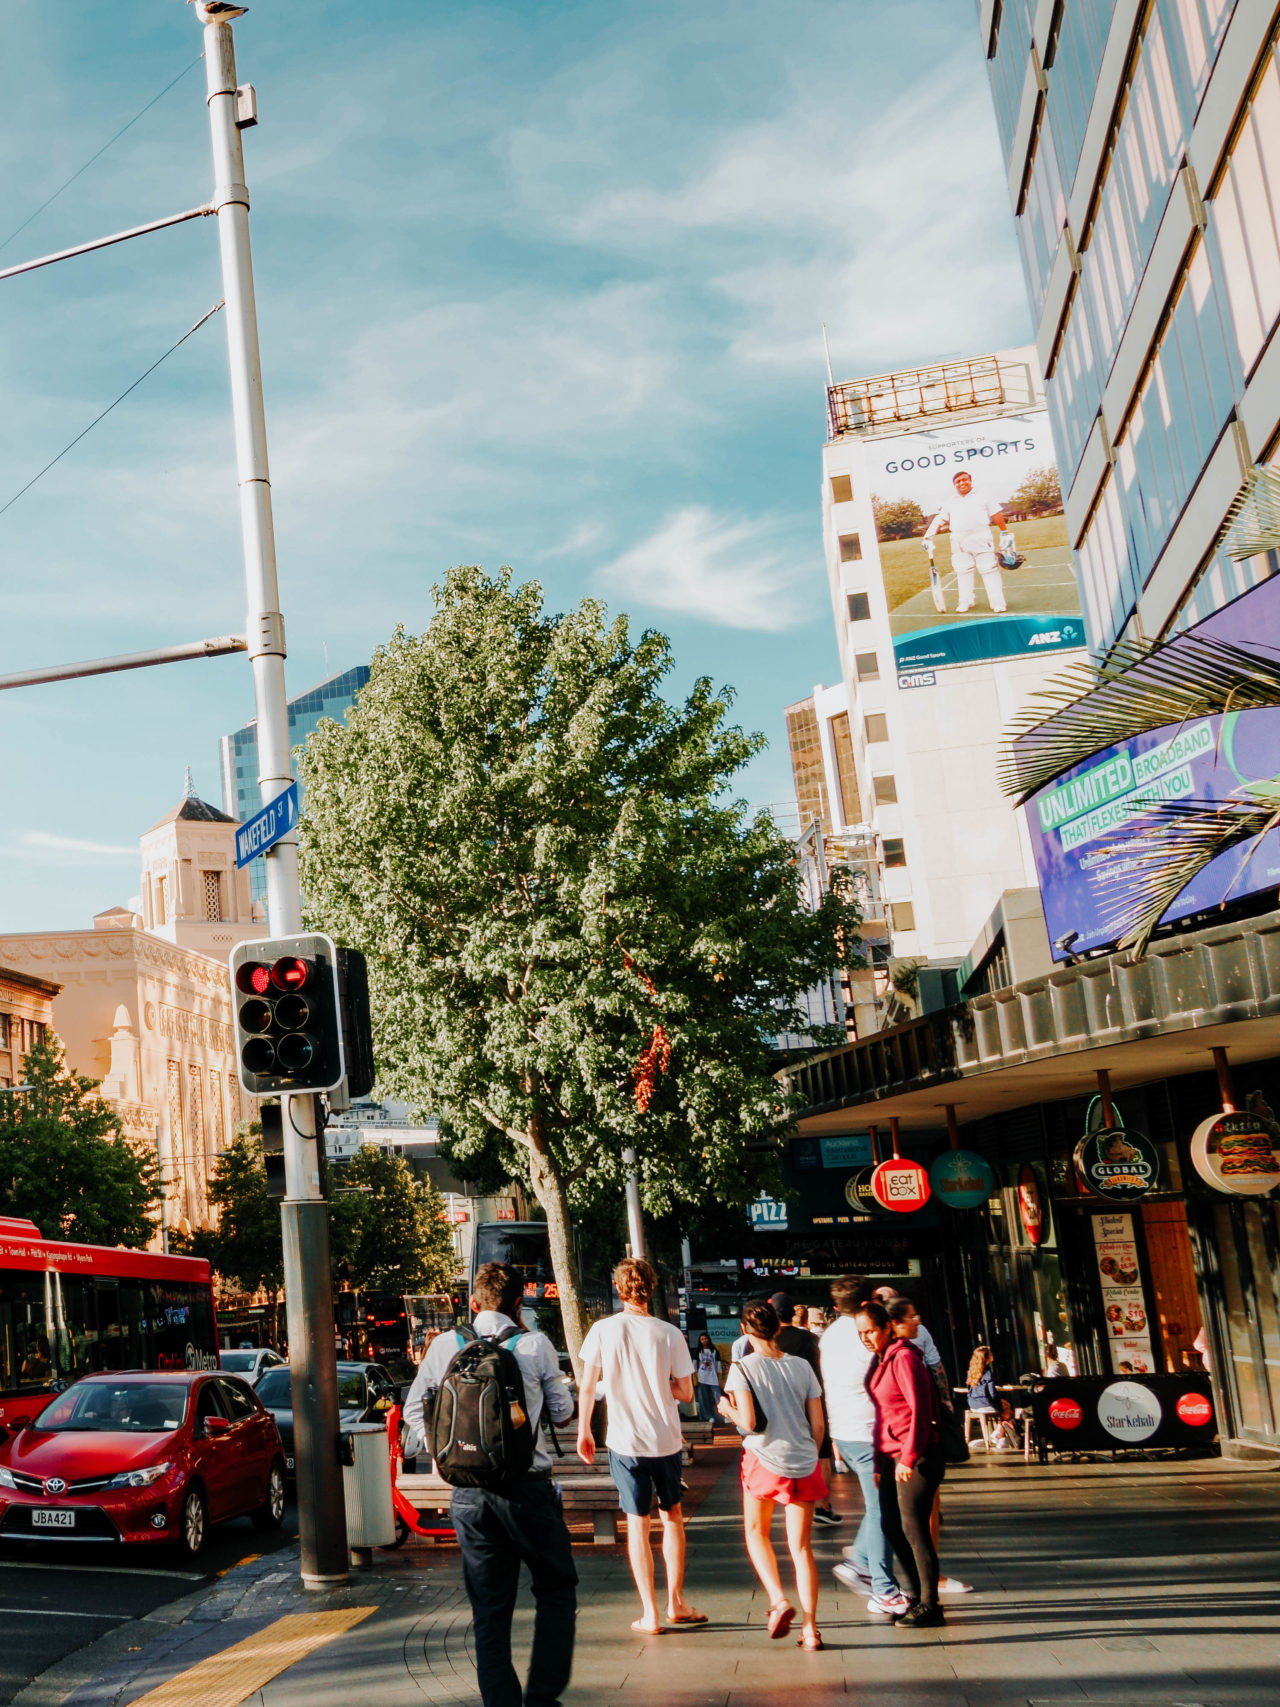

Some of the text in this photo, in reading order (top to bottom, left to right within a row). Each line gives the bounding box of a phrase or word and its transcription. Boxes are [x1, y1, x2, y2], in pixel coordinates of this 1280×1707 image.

[885, 438, 1036, 474] GOOD SPORTS
[1028, 631, 1062, 646] ANZ
[898, 672, 935, 689] QMS
[1039, 727, 1211, 827] UNLIMITED BROADBAND
[1062, 821, 1088, 847] THAT
[1090, 801, 1129, 832] FLEXES
[1130, 784, 1161, 813] WITH
[1163, 770, 1191, 797] YOU
[238, 801, 283, 860] WAKEFIELD ST
[1098, 1166, 1146, 1175] GLOBAL
[890, 1173, 914, 1186] eat
[889, 1185, 917, 1197] box
[544, 1283, 560, 1298] 25
[195, 1348, 218, 1370] Metro
[33, 1512, 75, 1525] JBA421
